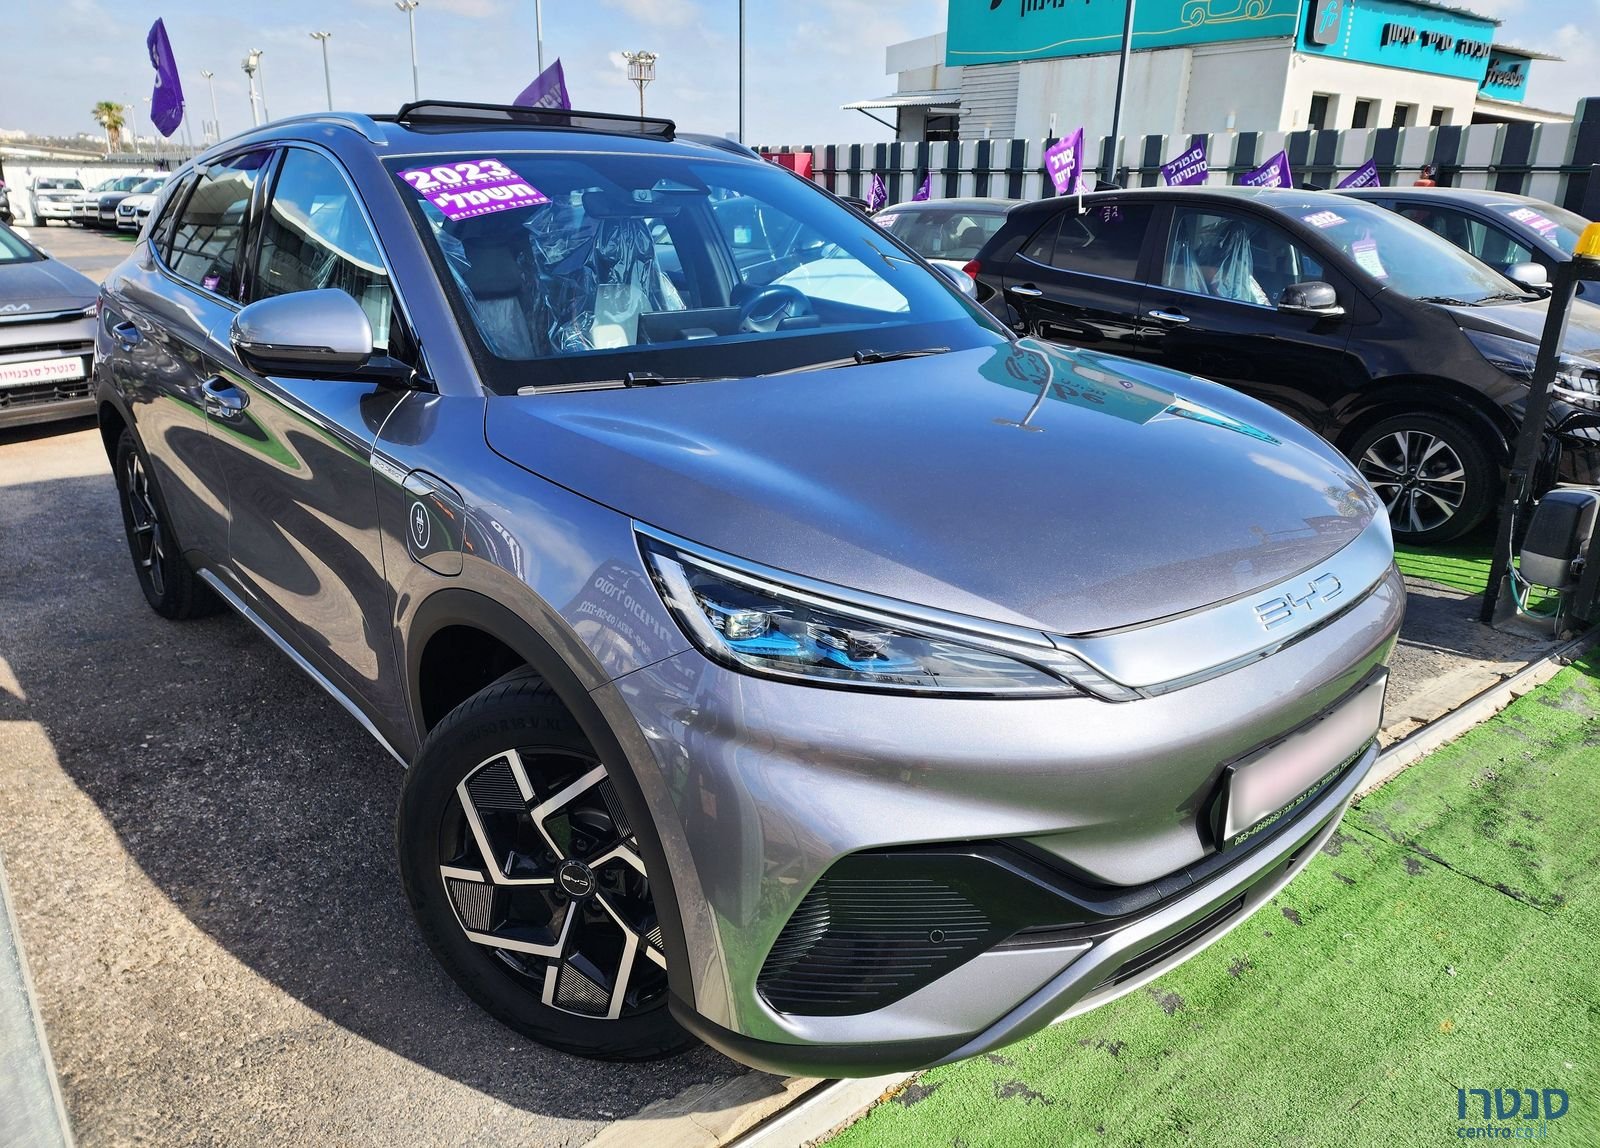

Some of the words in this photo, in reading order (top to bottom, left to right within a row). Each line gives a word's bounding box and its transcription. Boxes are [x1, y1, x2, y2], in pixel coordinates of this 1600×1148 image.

[1167, 148, 1203, 173] סנטרל
[404, 160, 511, 190] 2023
[434, 184, 537, 209] חשמלי
[44, 363, 76, 376] סנטרל
[1252, 572, 1344, 631] BYD
[562, 874, 589, 887] BYD
